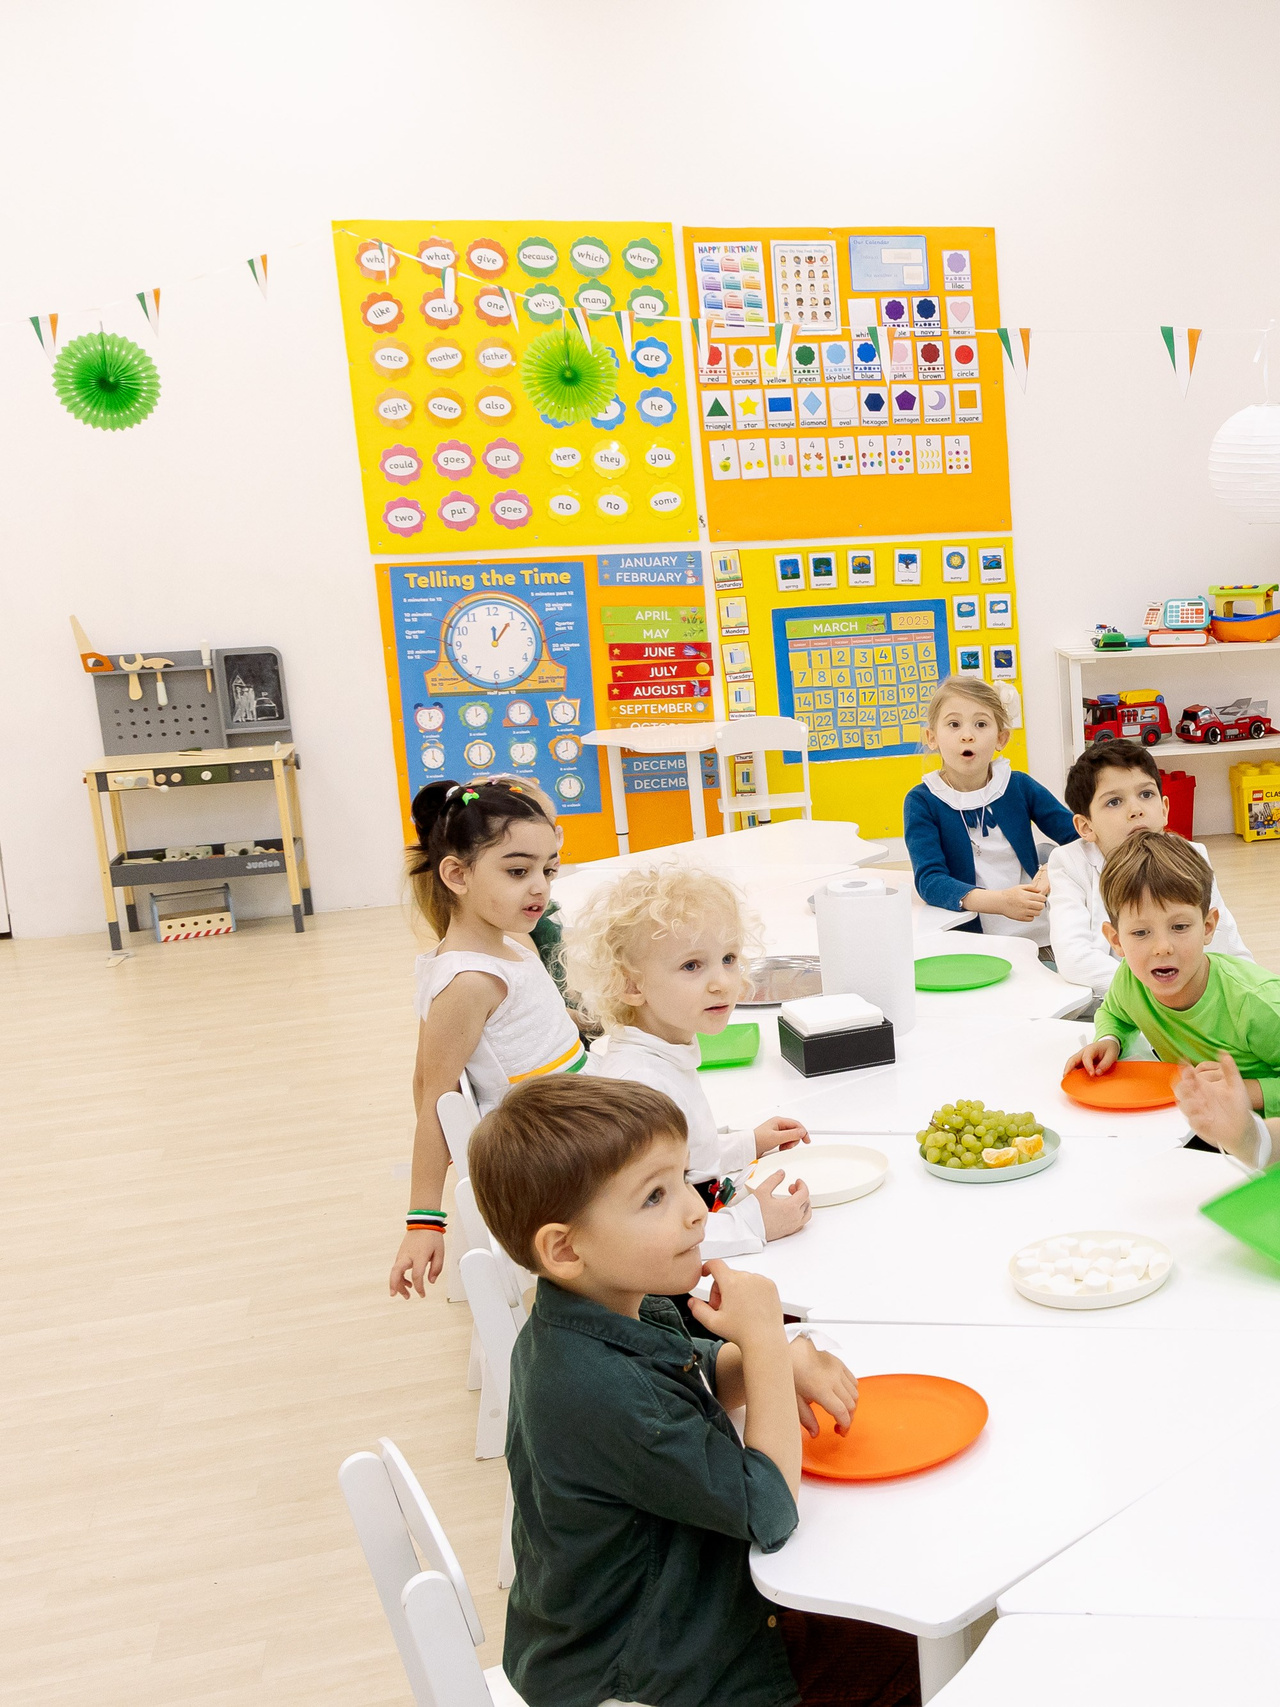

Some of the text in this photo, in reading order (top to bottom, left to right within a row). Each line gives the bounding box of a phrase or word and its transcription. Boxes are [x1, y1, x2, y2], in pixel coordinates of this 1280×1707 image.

[426, 253, 450, 261] what
[477, 256, 497, 265] give
[522, 252, 554, 261] because
[577, 250, 604, 264] which
[630, 253, 655, 264] where
[487, 301, 504, 311] one
[583, 296, 607, 307] many
[372, 305, 391, 318] like
[639, 302, 657, 312] any
[380, 354, 403, 362] once
[430, 351, 459, 362] mother
[482, 351, 508, 362] father
[642, 352, 660, 362] are
[734, 377, 756, 385] orange
[767, 376, 786, 385] yellow
[798, 375, 816, 384] green
[894, 372, 907, 380] pink
[384, 403, 407, 415] eight
[432, 403, 457, 414] cover
[485, 401, 505, 410] also
[651, 402, 663, 411] he
[769, 420, 794, 428] rectangle
[863, 418, 888, 426] hexagon
[894, 416, 919, 424] pentagon
[959, 415, 979, 424] square
[706, 423, 731, 431] triangle
[750, 442, 755, 450] 2
[780, 441, 786, 449] 3
[810, 441, 815, 449] 4
[839, 440, 844, 448] 5
[868, 439, 874, 447] 6
[897, 438, 902, 446] 7
[444, 455, 465, 465] goes
[495, 453, 511, 463] put
[555, 452, 576, 461] here
[600, 453, 620, 467] they
[650, 452, 671, 463] you
[389, 461, 413, 470] could
[558, 501, 572, 511] no
[606, 500, 620, 510] no
[654, 496, 677, 506] some
[451, 507, 467, 517] put
[501, 505, 522, 515] goes
[620, 556, 678, 568] JANUARY
[404, 567, 571, 590] Telling the Time
[616, 572, 682, 583] FEBRUARY
[487, 607, 499, 616] 12
[509, 612, 515, 620] 1
[636, 611, 671, 621] APRIL
[466, 613, 476, 622] 11
[898, 616, 929, 626] 2025
[457, 627, 468, 635] 10
[521, 622, 527, 631] 2
[813, 622, 858, 633] MARCH
[643, 629, 669, 638] MAY
[456, 641, 462, 650] 9
[527, 637, 533, 646] 3
[522, 653, 528, 661] 4
[643, 647, 675, 658] JUNE
[818, 646, 931, 664] 1 2 3 4 5 6
[462, 655, 468, 664] 8
[475, 666, 481, 674] 7
[494, 671, 499, 679] 6
[509, 667, 514, 676] 5
[649, 666, 678, 678] JULY
[798, 665, 936, 683] 7 8 6 10 11 12 13
[633, 685, 686, 696] AUGUST
[797, 696, 811, 707] 14
[817, 693, 832, 704] 15
[840, 692, 854, 703] 16
[862, 692, 875, 702] 17
[881, 690, 895, 701] 18
[901, 687, 915, 698] 19
[619, 703, 692, 715] SEPTEMBER
[816, 715, 832, 726] 22
[840, 712, 854, 722] 23
[859, 713, 874, 722] 24
[882, 711, 897, 722] 25
[901, 709, 917, 720] 26
[921, 707, 927, 717] 2
[821, 733, 836, 745] 29
[844, 732, 859, 743] 30
[866, 734, 880, 745] 31
[633, 760, 685, 771] DECEMB
[634, 778, 686, 789] DECEMB
